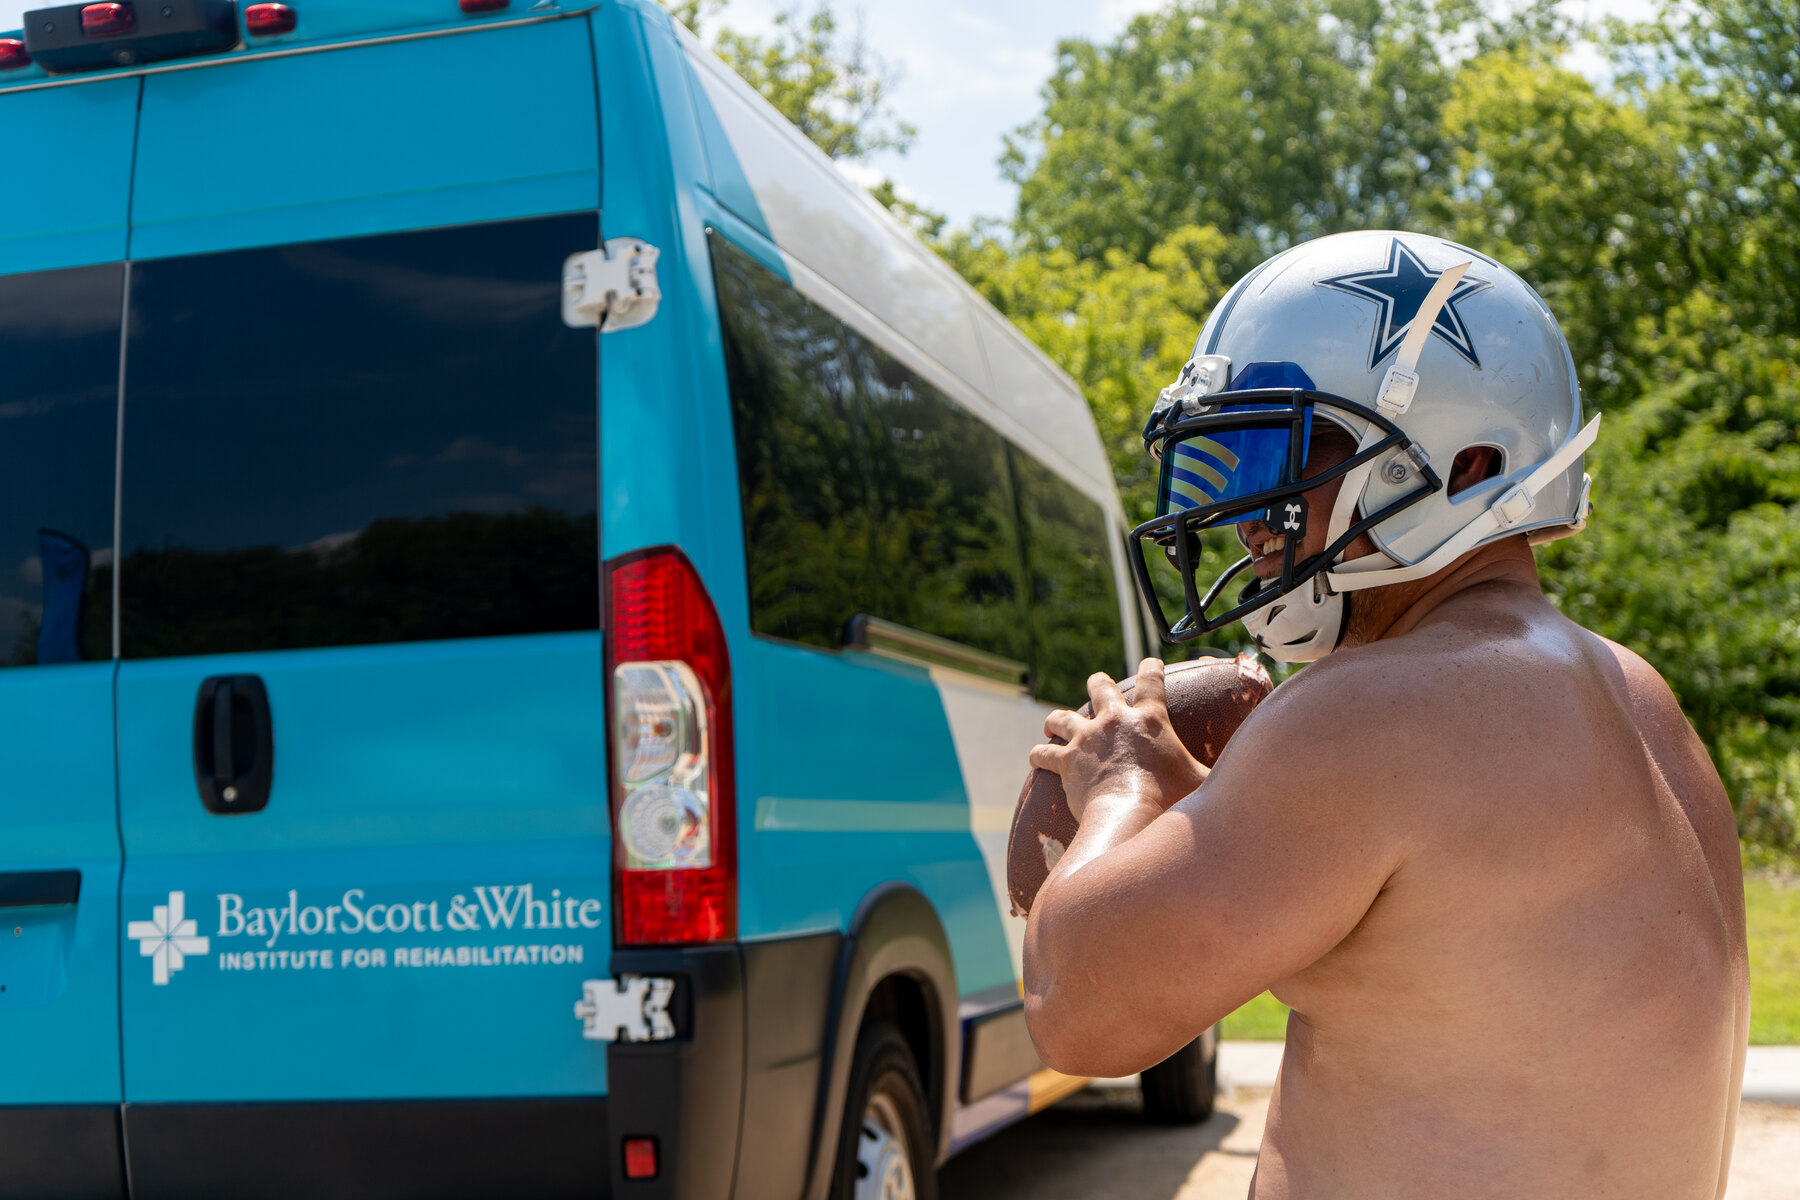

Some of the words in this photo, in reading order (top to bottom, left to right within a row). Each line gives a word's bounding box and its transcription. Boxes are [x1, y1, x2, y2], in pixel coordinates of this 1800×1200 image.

[219, 949, 334, 971] INSTITUTE
[341, 948, 387, 968] FOR
[393, 944, 584, 968] REHABILITATION
